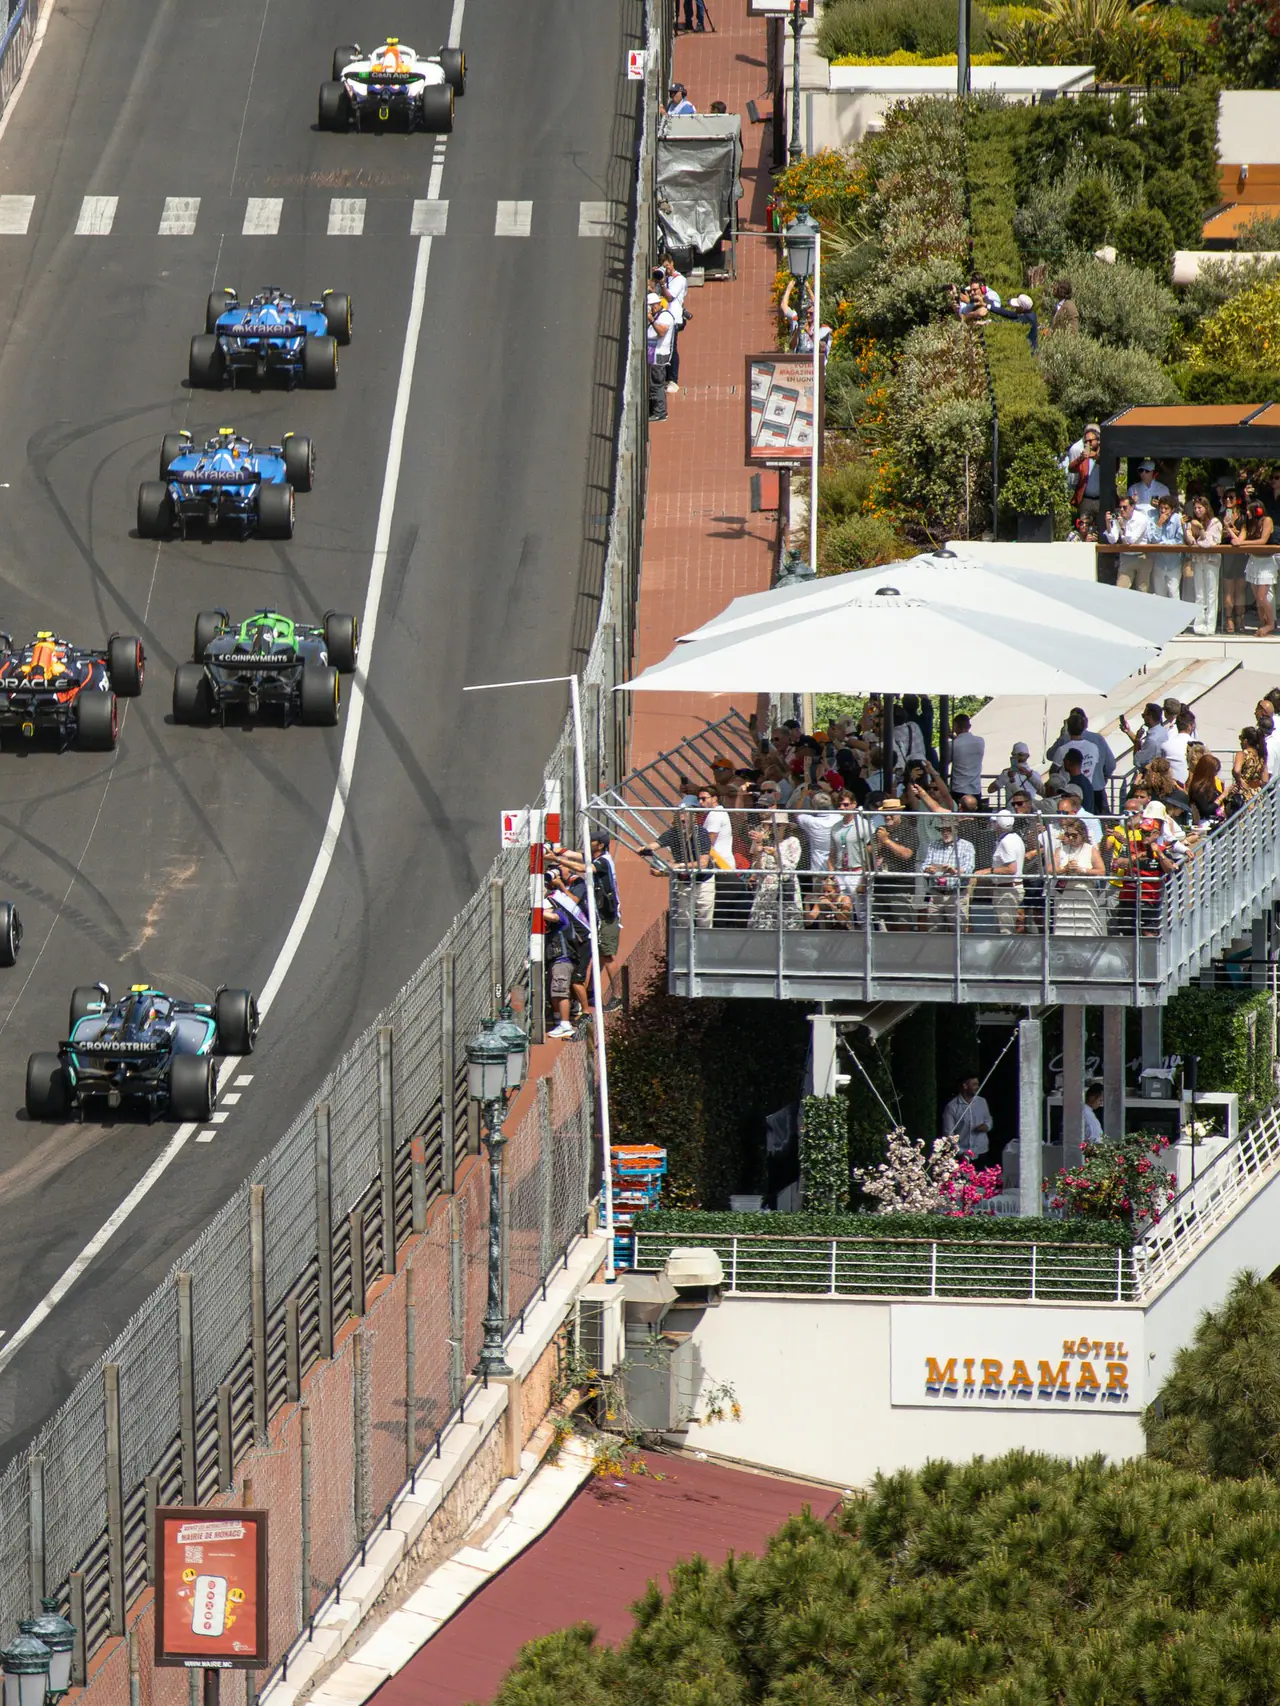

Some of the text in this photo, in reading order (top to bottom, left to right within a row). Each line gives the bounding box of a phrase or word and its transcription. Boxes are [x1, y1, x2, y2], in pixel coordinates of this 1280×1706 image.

[244, 325, 292, 334] kraken
[195, 470, 245, 481] kraken
[224, 654, 288, 663] COINPAYMENTS
[79, 1041, 157, 1052] CROWDSTRIKE
[1062, 1336, 1129, 1358] HÔTEL
[925, 1356, 1129, 1390] MIRAMAR
